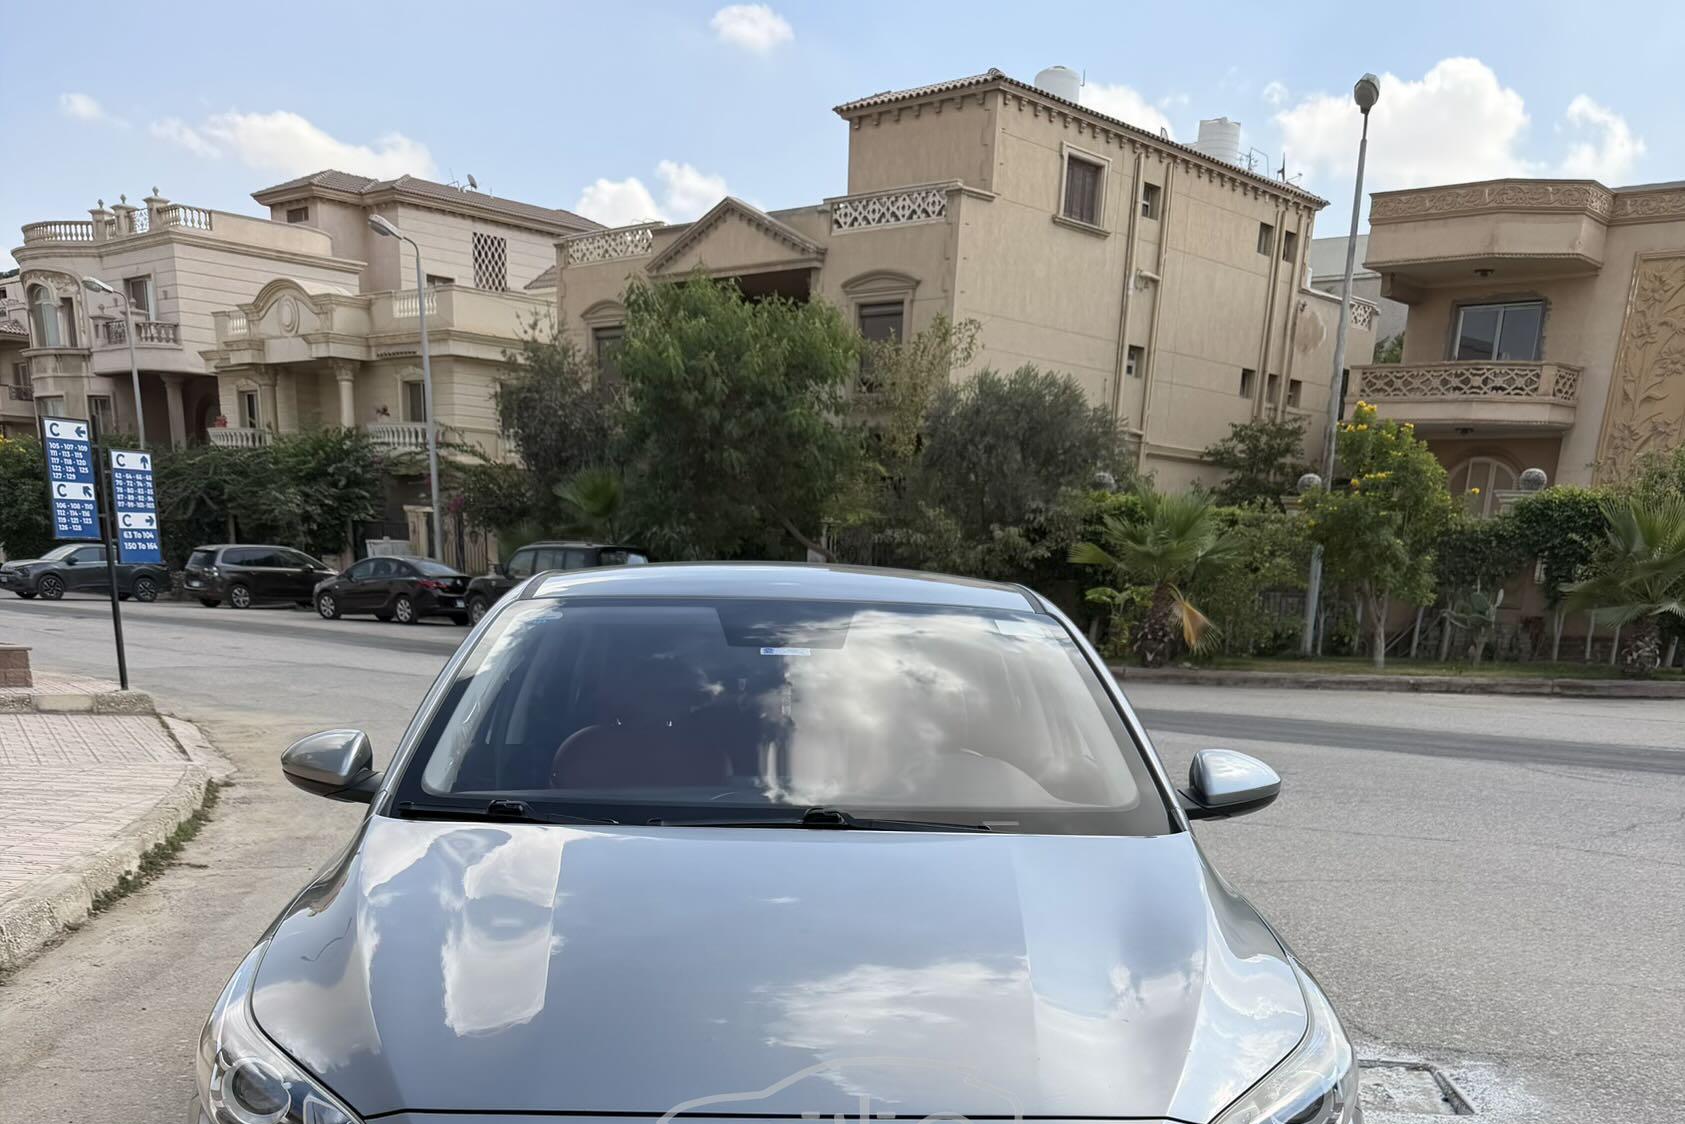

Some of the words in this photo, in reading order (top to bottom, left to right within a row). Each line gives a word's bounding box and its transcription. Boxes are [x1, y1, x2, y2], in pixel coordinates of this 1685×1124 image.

[50, 423, 60, 436] C
[116, 454, 125, 466] C
[57, 484, 67, 497] C
[122, 514, 132, 527] C
[133, 531, 142, 539] To
[142, 531, 154, 539] 104
